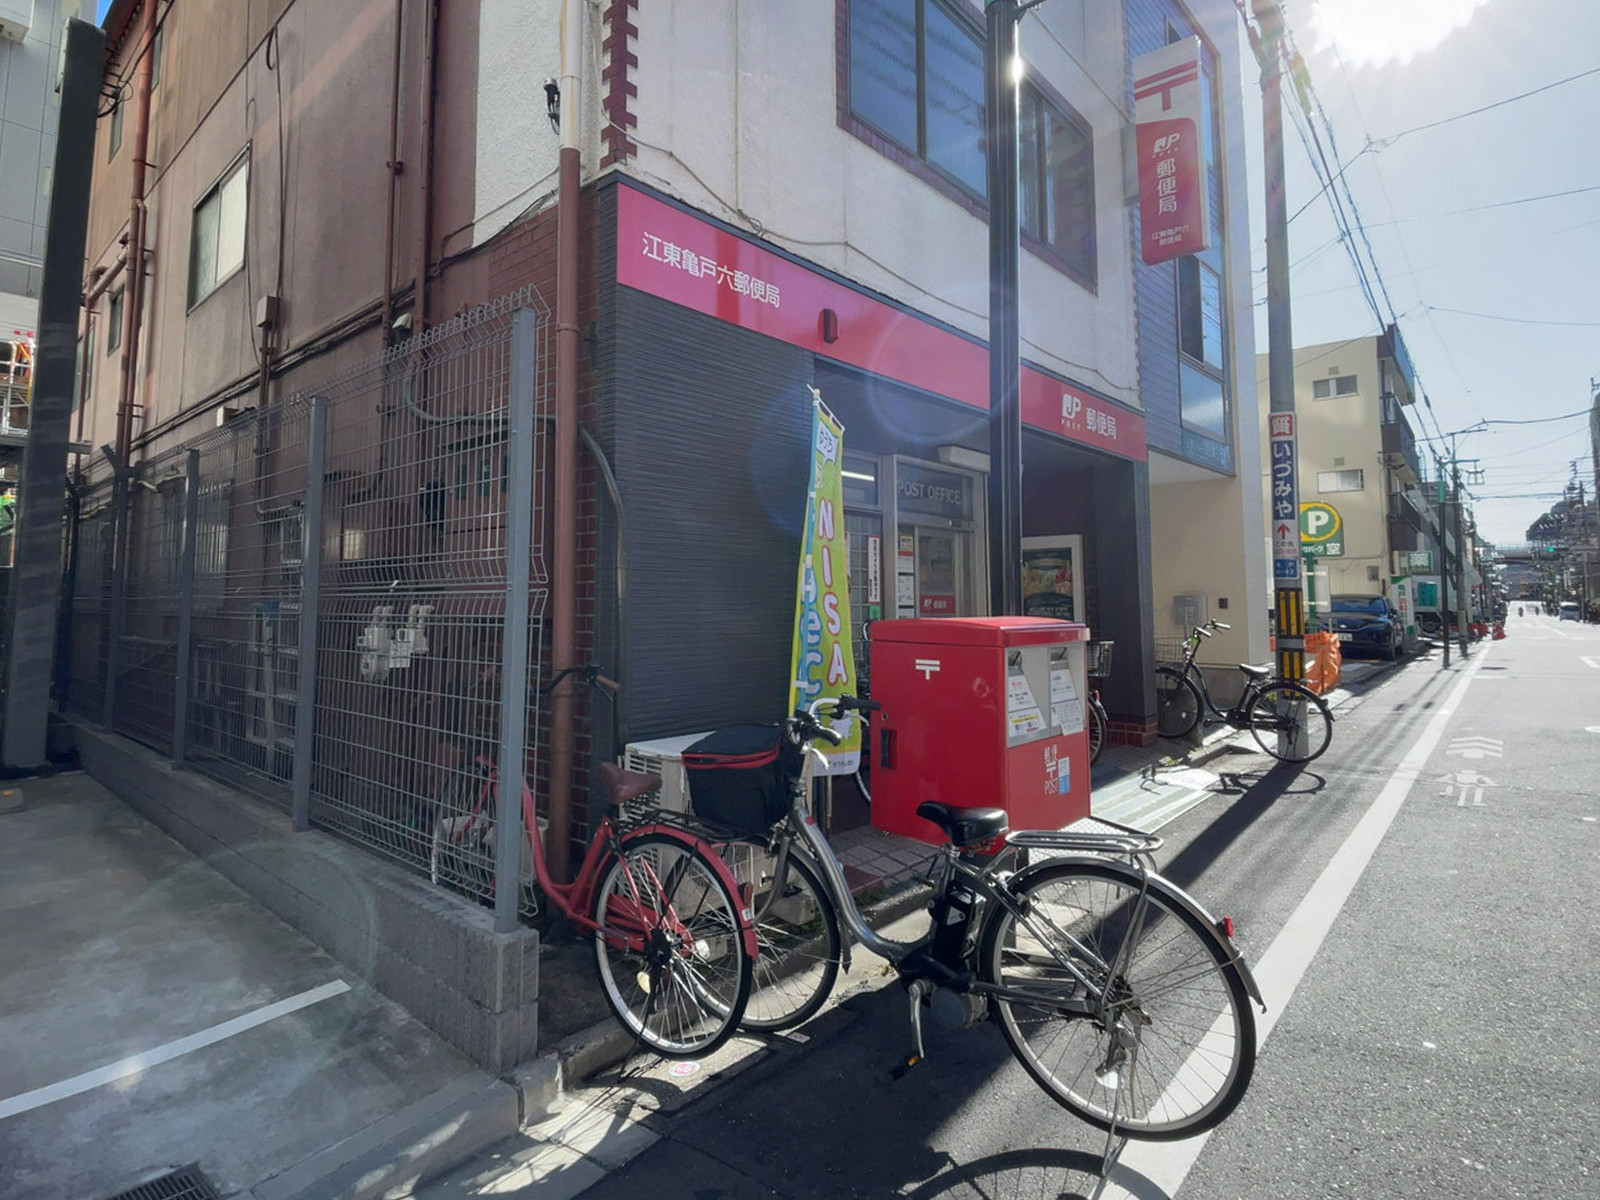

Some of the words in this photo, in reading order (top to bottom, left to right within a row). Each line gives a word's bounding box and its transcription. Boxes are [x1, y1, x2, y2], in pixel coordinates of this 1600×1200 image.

[1156, 158, 1178, 216] 郵便局
[642, 231, 781, 308] 江東亀戸六郵便局
[1086, 407, 1117, 440] 郵便局
[1272, 416, 1291, 435] 質
[897, 479, 925, 499] POST
[927, 485, 961, 505] OFFICE
[1273, 443, 1292, 519] いづみや
[1307, 510, 1330, 534] P
[817, 497, 848, 686] NISA
